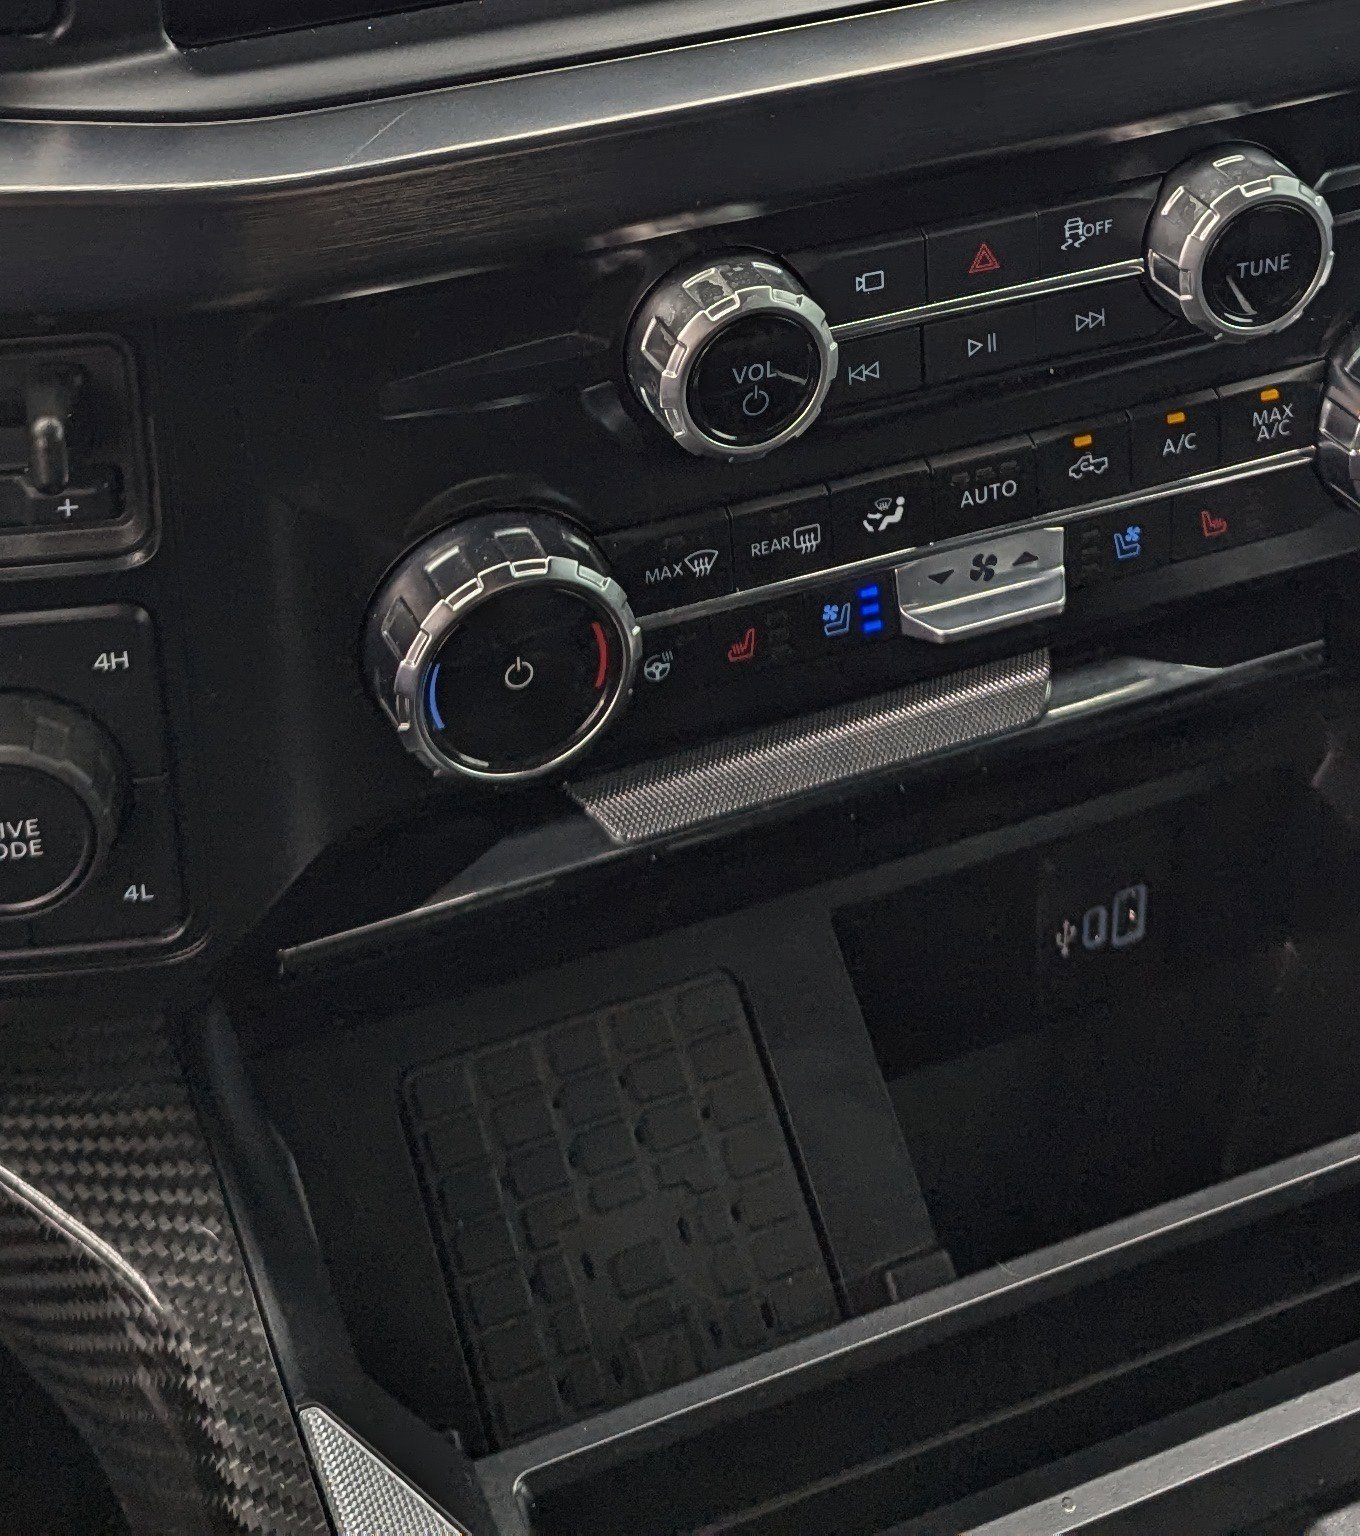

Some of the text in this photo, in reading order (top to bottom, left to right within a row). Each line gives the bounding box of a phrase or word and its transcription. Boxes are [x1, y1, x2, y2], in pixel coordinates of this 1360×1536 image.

[1083, 218, 1113, 238] OFF
[1237, 252, 1292, 279] TUNE
[732, 362, 778, 385] VOL
[1252, 402, 1294, 428] MAX
[1256, 417, 1292, 443] A/C
[1162, 431, 1198, 456] A/C
[960, 478, 1018, 508] AUTO
[750, 534, 792, 559] REAR
[645, 563, 684, 586] MAX
[93, 650, 130, 672] 4H
[123, 883, 155, 902] 4L
